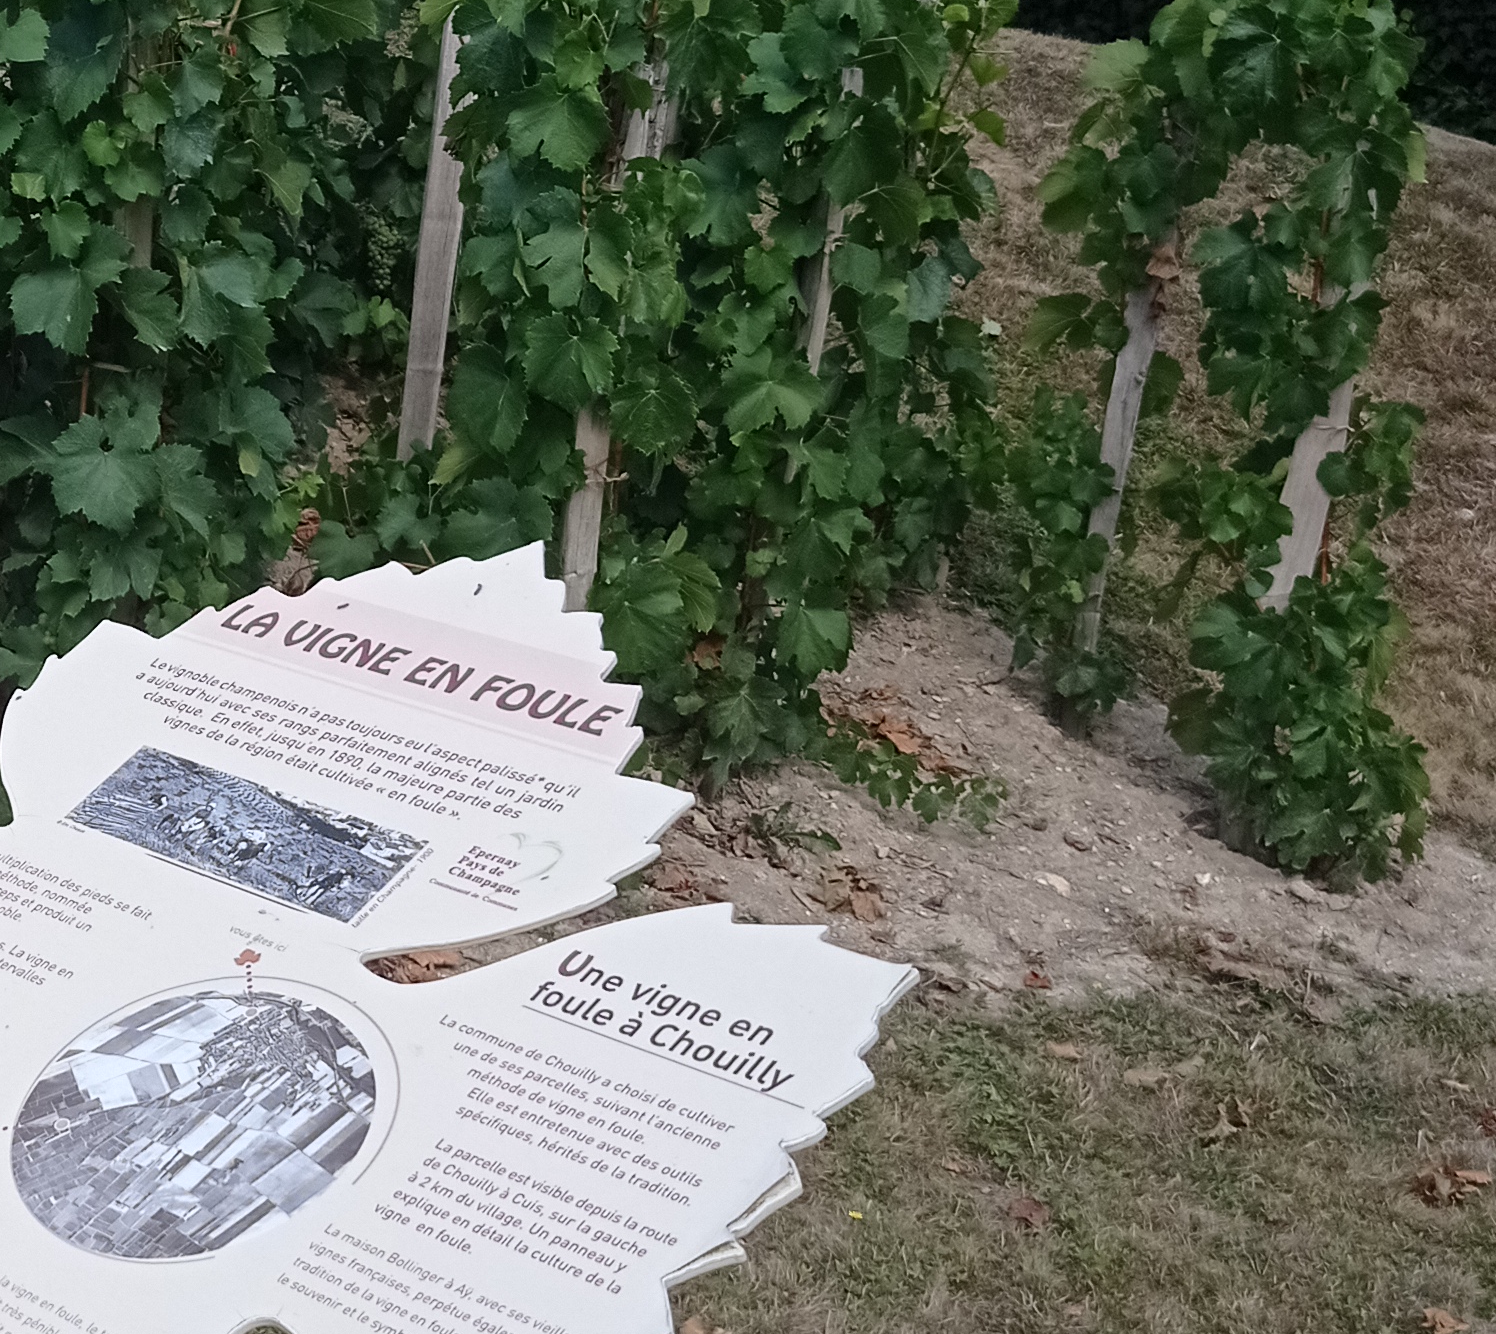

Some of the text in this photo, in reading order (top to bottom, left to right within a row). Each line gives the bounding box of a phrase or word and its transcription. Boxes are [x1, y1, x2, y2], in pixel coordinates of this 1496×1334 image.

[219, 603, 625, 737] LA VIGNE EN FOULE
[135, 671, 565, 813] a aujourd'hui avec ses rangs parfaitement alignés tel un jardin
[149, 657, 168, 670] Le
[166, 663, 221, 687] vignoble
[218, 680, 300, 712] champenois
[315, 713, 347, 727] pas
[344, 719, 406, 745] toujours
[403, 739, 426, 751] eu
[422, 742, 483, 769] l'aspect
[542, 781, 582, 799] qu'il
[448, 866, 522, 897] Champagne
[457, 855, 505, 878] Pays de
[468, 845, 522, 870] Epernay
[529, 980, 796, 1094] foule à Chouilly
[557, 948, 774, 1046] Une vigne en
[438, 1013, 736, 1133] La commune de Chouilly a choisi de cultiver
[452, 1041, 721, 1151] une de ses parcelles, suivant l'ancienne
[422, 1156, 442, 1171] de
[442, 1163, 500, 1197] Chouilly
[498, 1186, 511, 1200] à
[547, 1210, 577, 1227] sur
[575, 1219, 592, 1235] la
[589, 1229, 648, 1258] gauche
[434, 1137, 678, 1247] La parcelle est visible depuis la route
[323, 1222, 341, 1238] La
[340, 1233, 386, 1259] maison
[385, 1251, 445, 1284] Bollinger
[443, 1277, 455, 1290] à
[475, 1294, 507, 1314] avec
[506, 1308, 532, 1324] ses
